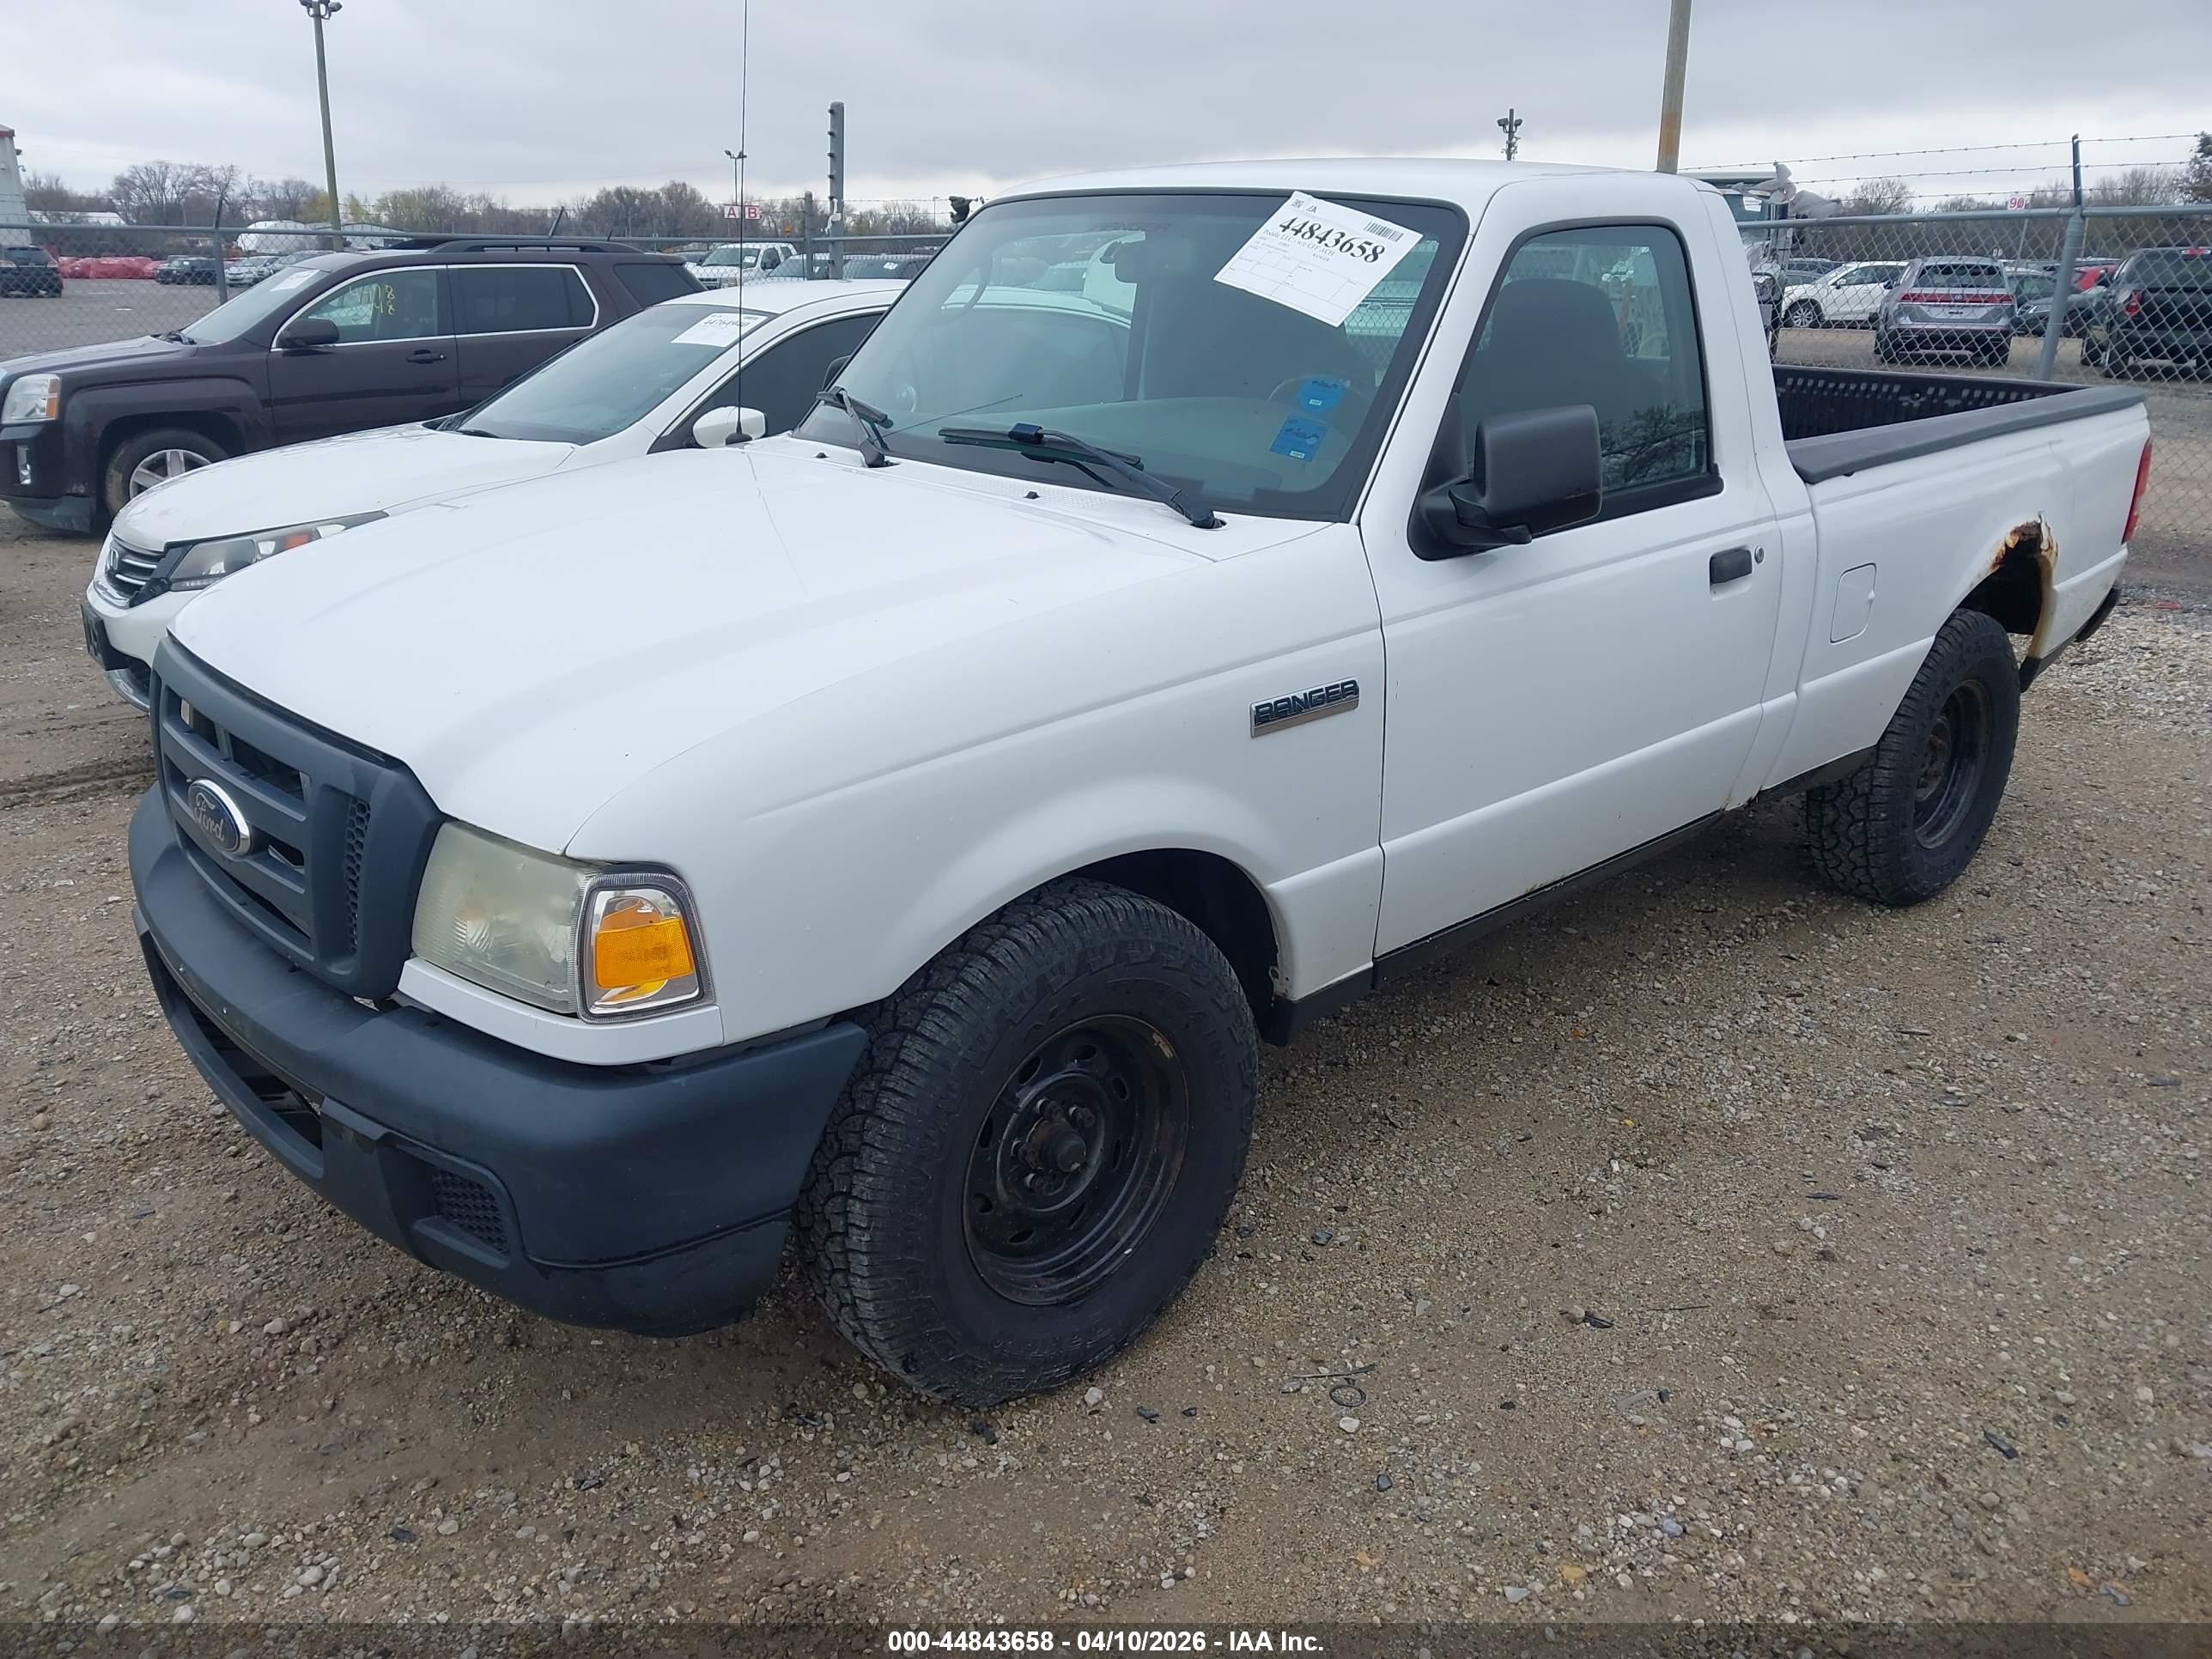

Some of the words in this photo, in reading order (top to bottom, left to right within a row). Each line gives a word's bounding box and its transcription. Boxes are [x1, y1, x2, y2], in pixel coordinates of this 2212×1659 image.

[727, 207, 737, 217] A
[748, 207, 757, 218] B
[1279, 216, 1386, 264] 44843658
[1253, 678, 1360, 727] RANGER
[193, 792, 225, 842] Ford
